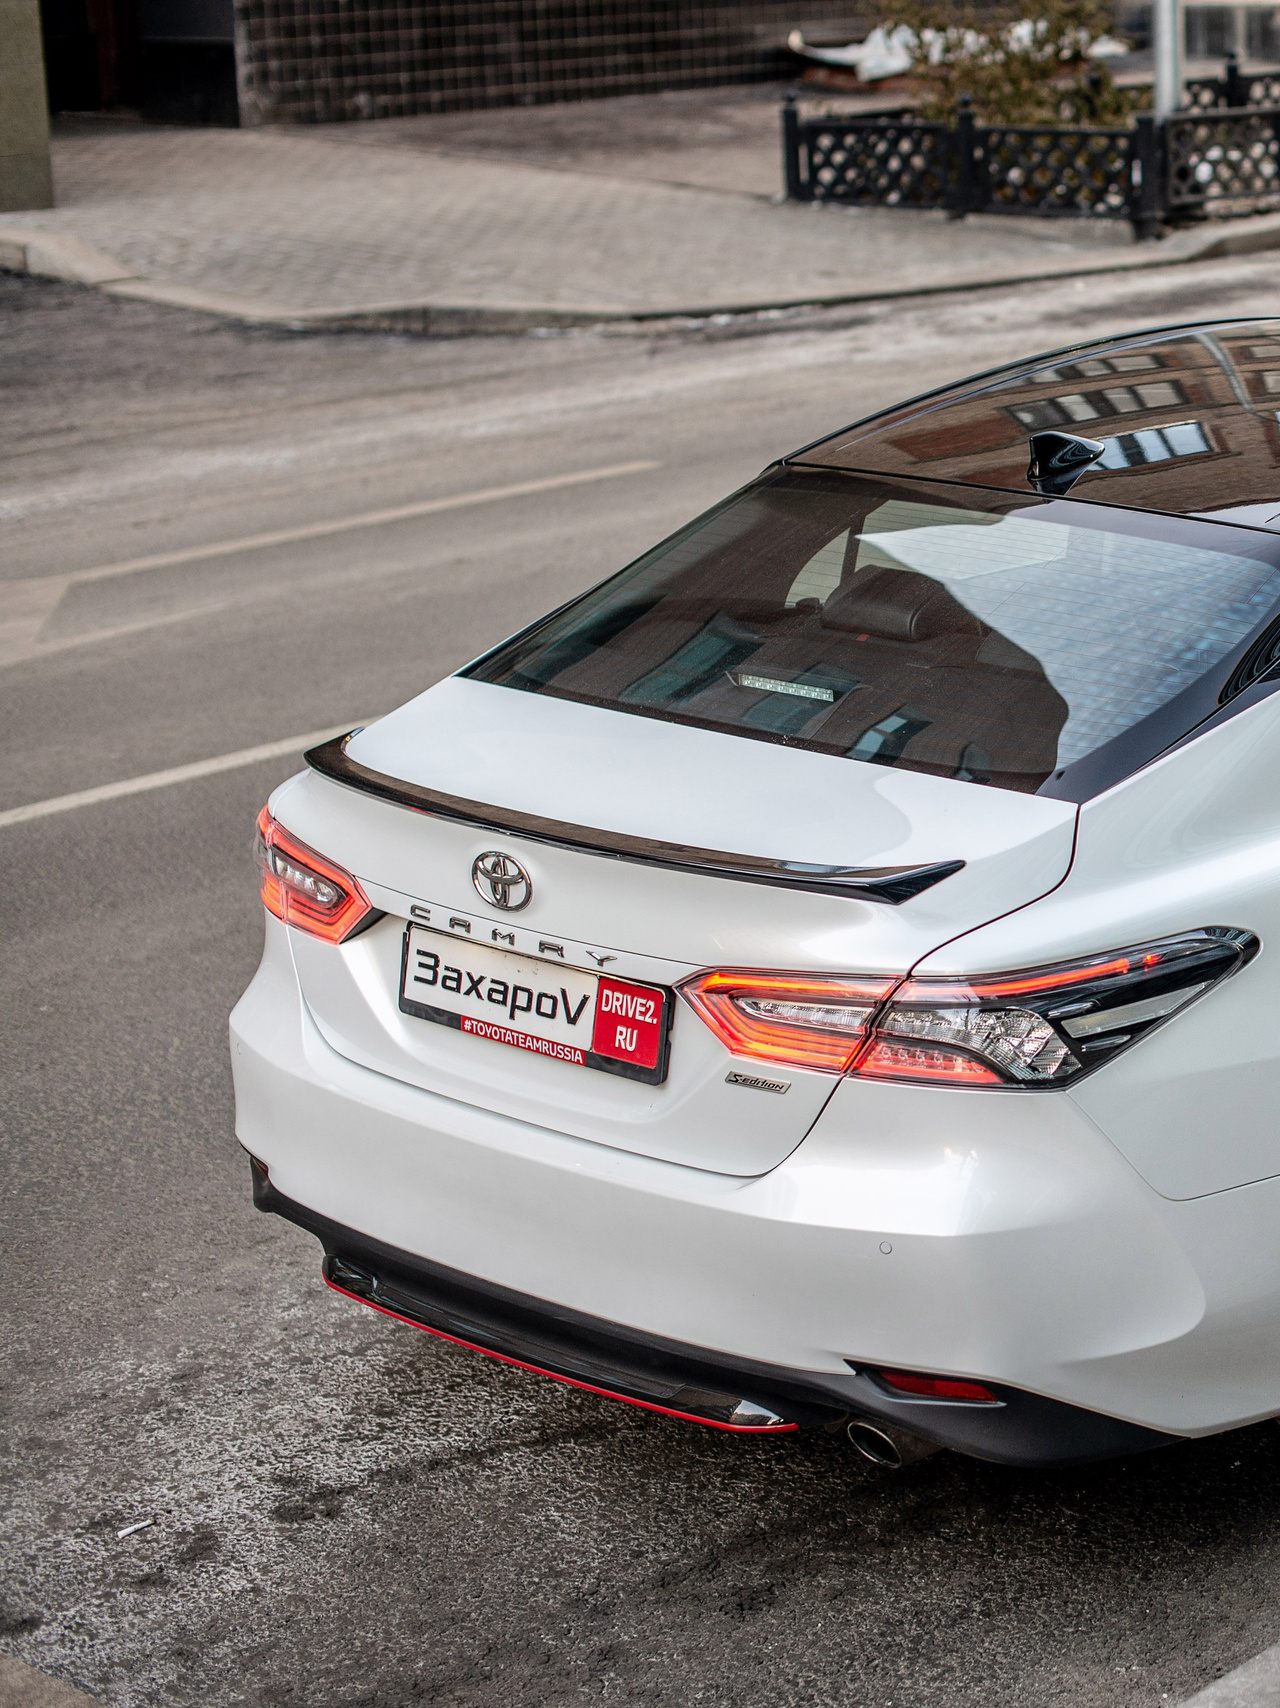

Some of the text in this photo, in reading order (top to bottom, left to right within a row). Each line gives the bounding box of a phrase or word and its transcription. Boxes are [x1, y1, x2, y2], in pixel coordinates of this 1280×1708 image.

[410, 904, 618, 967] CAMRY
[601, 989, 657, 1024] DRIVE2.
[464, 1019, 583, 1064] #TOYOTATEAMRUSSIA
[615, 1025, 638, 1052] RU
